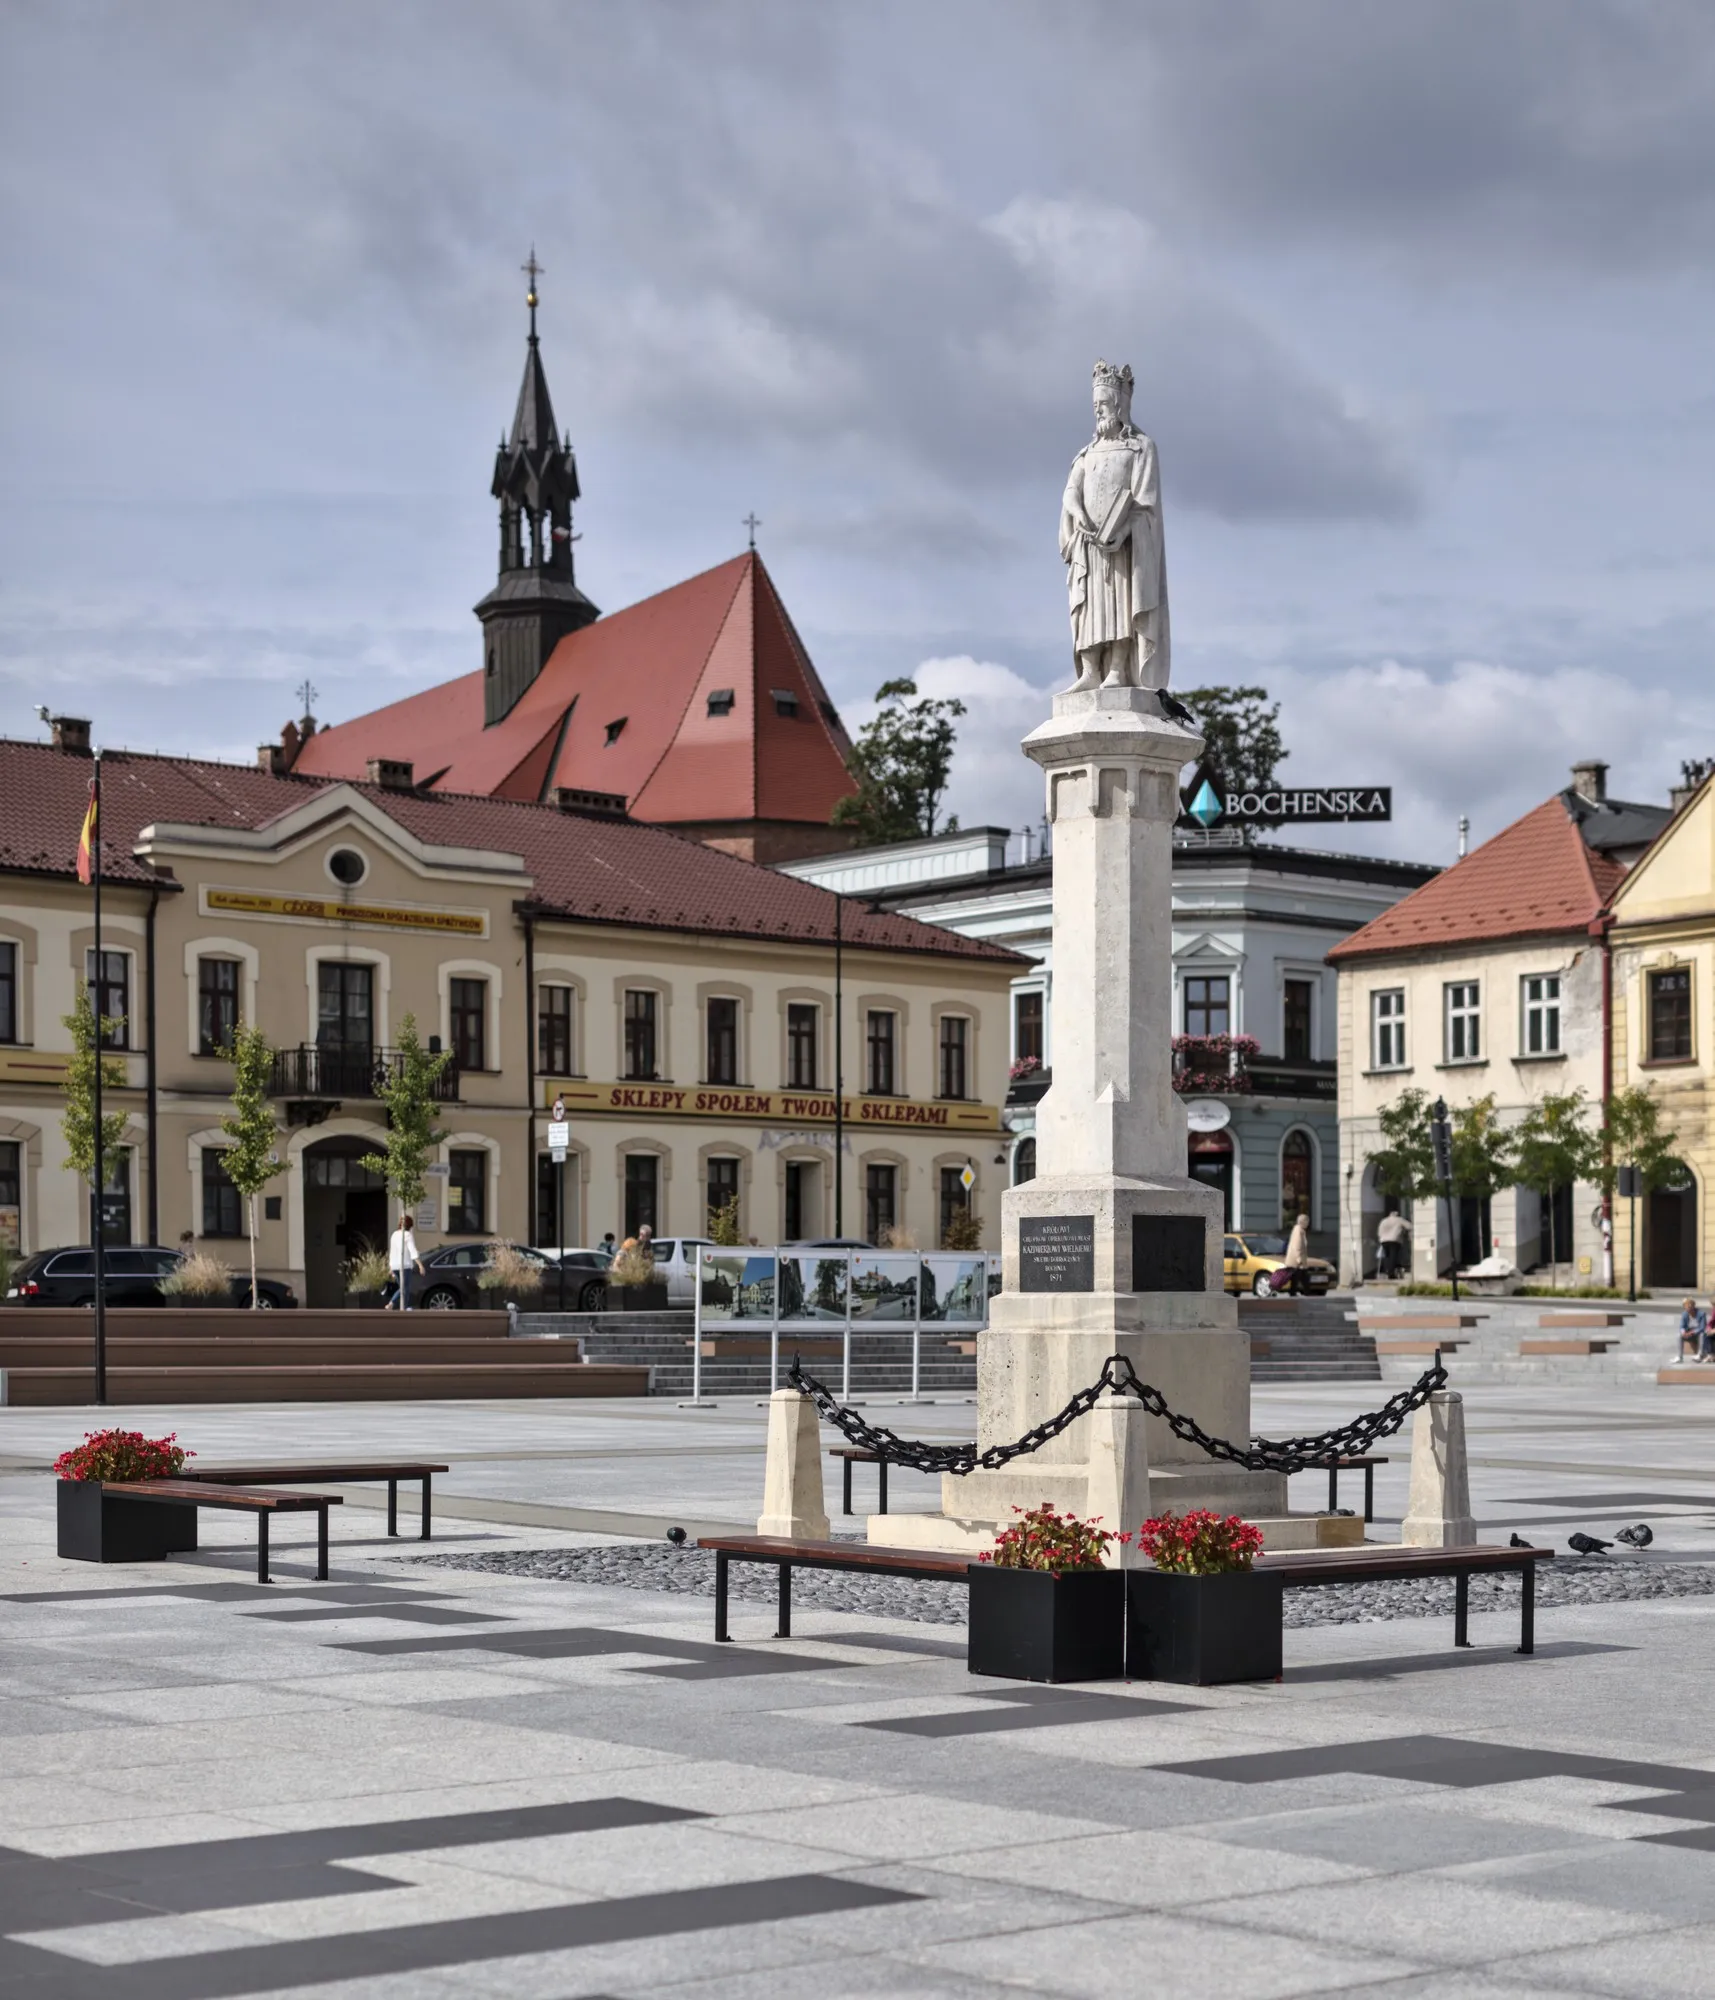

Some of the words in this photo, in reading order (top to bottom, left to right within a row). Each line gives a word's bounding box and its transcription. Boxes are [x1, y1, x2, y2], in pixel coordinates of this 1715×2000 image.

[1225, 789, 1386, 816] BOCHEŃSKA
[610, 1088, 687, 1110] SKLEPY
[695, 1093, 771, 1114] SPOŁEM
[781, 1097, 852, 1119] TWOIMI
[860, 1102, 949, 1125] SKLEPAMI
